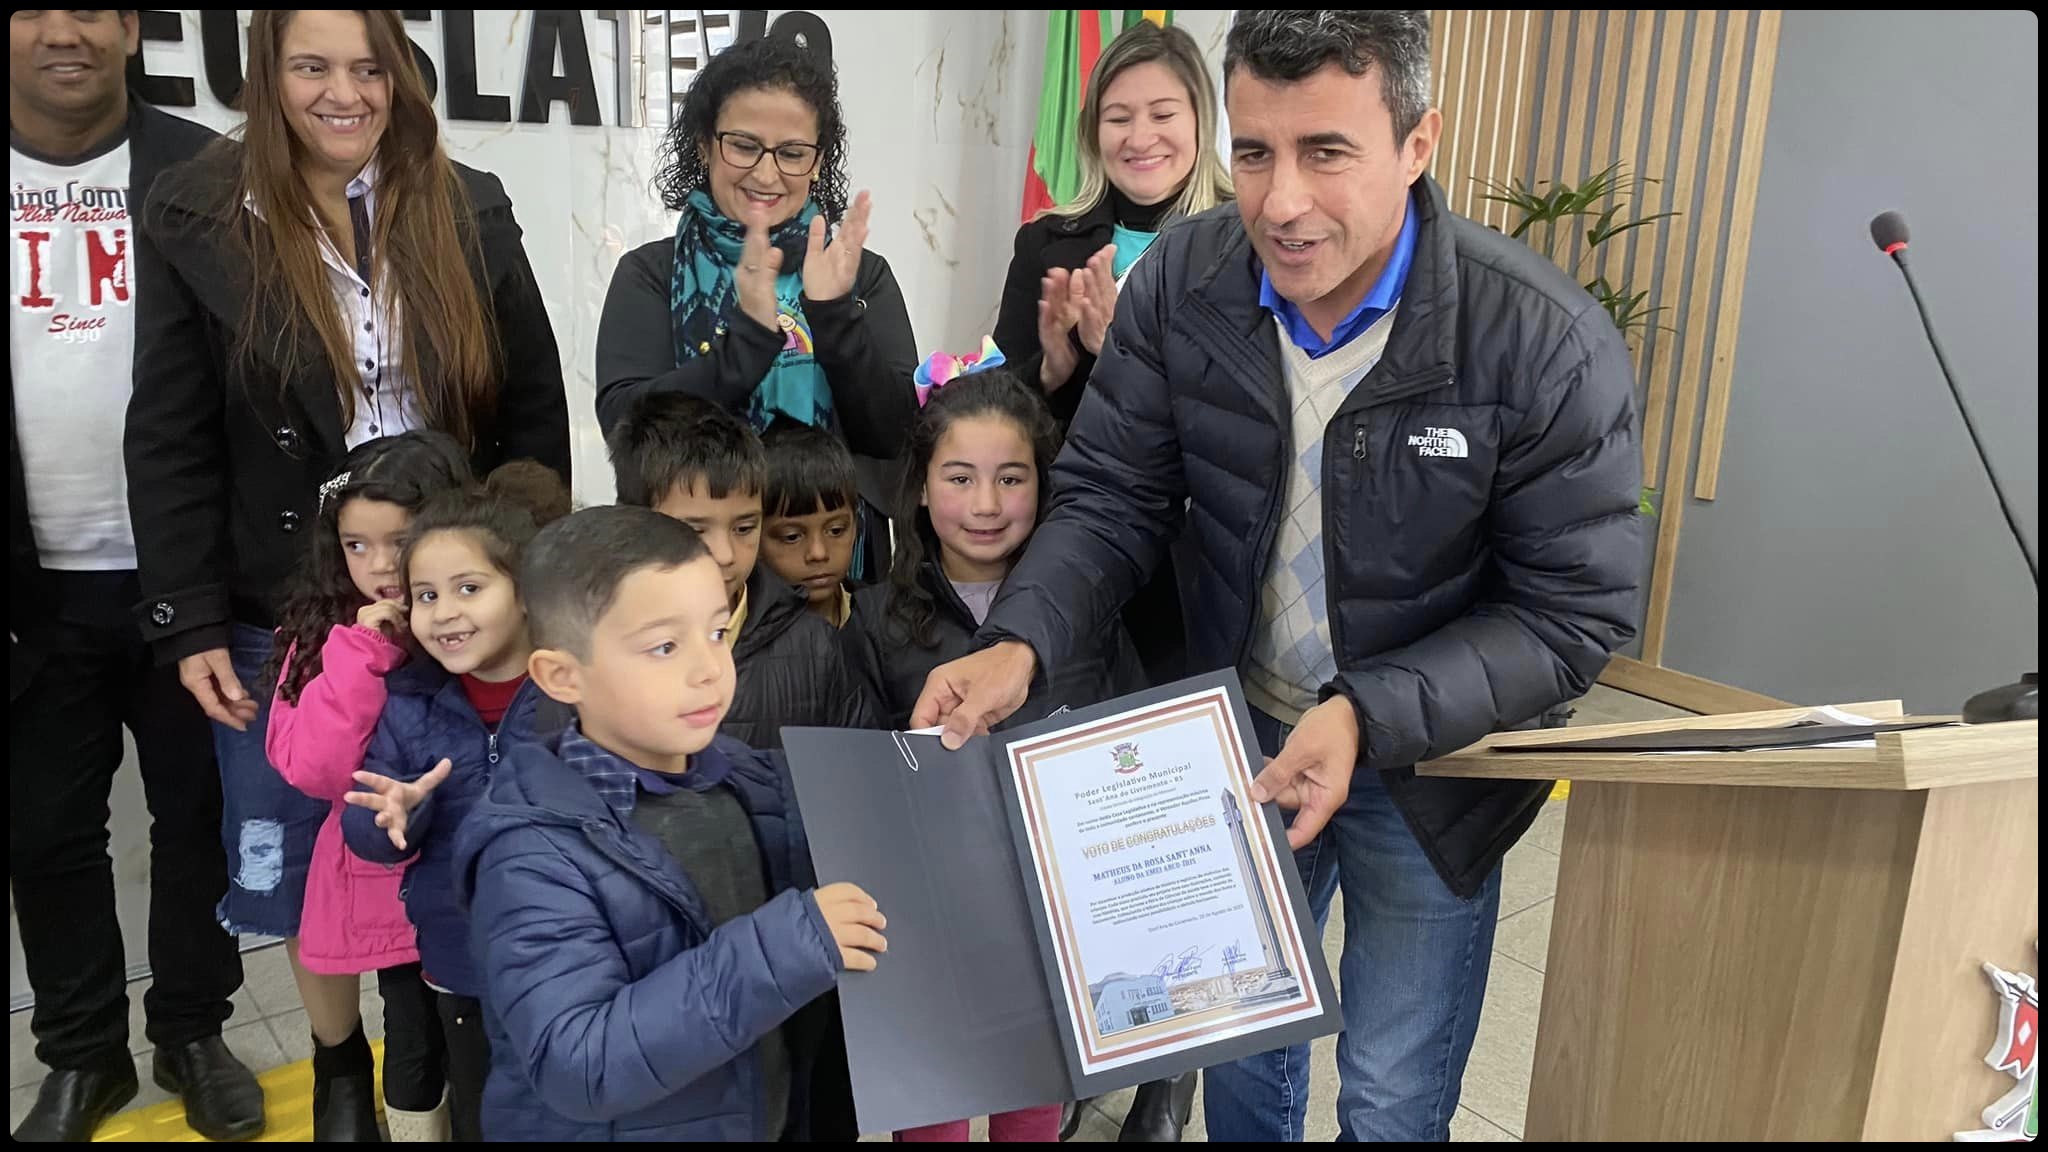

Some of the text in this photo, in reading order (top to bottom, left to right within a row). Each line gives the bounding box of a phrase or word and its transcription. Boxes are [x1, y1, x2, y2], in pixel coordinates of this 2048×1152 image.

[57, 203, 127, 223] Nativa
[48, 313, 107, 333] Since
[1407, 435, 1446, 447] NORTH
[1424, 427, 1448, 437] THE
[1419, 447, 1447, 457] FACE
[1074, 787, 1100, 800] Poder
[1101, 774, 1147, 794] Legislativo
[1149, 762, 1192, 780] Municipal
[1119, 789, 1129, 797] do
[1130, 779, 1168, 794] Livramento
[1082, 842, 1110, 860] VOTO
[1110, 838, 1126, 852] DE
[1125, 813, 1217, 849] CONGRATULAÇÕES
[1093, 843, 1212, 881] MATHEUS DA ROSA SANT'ANNA
[1113, 874, 1136, 885] ALUNO
[1136, 871, 1145, 879] DA
[1145, 866, 1163, 877] EMEI
